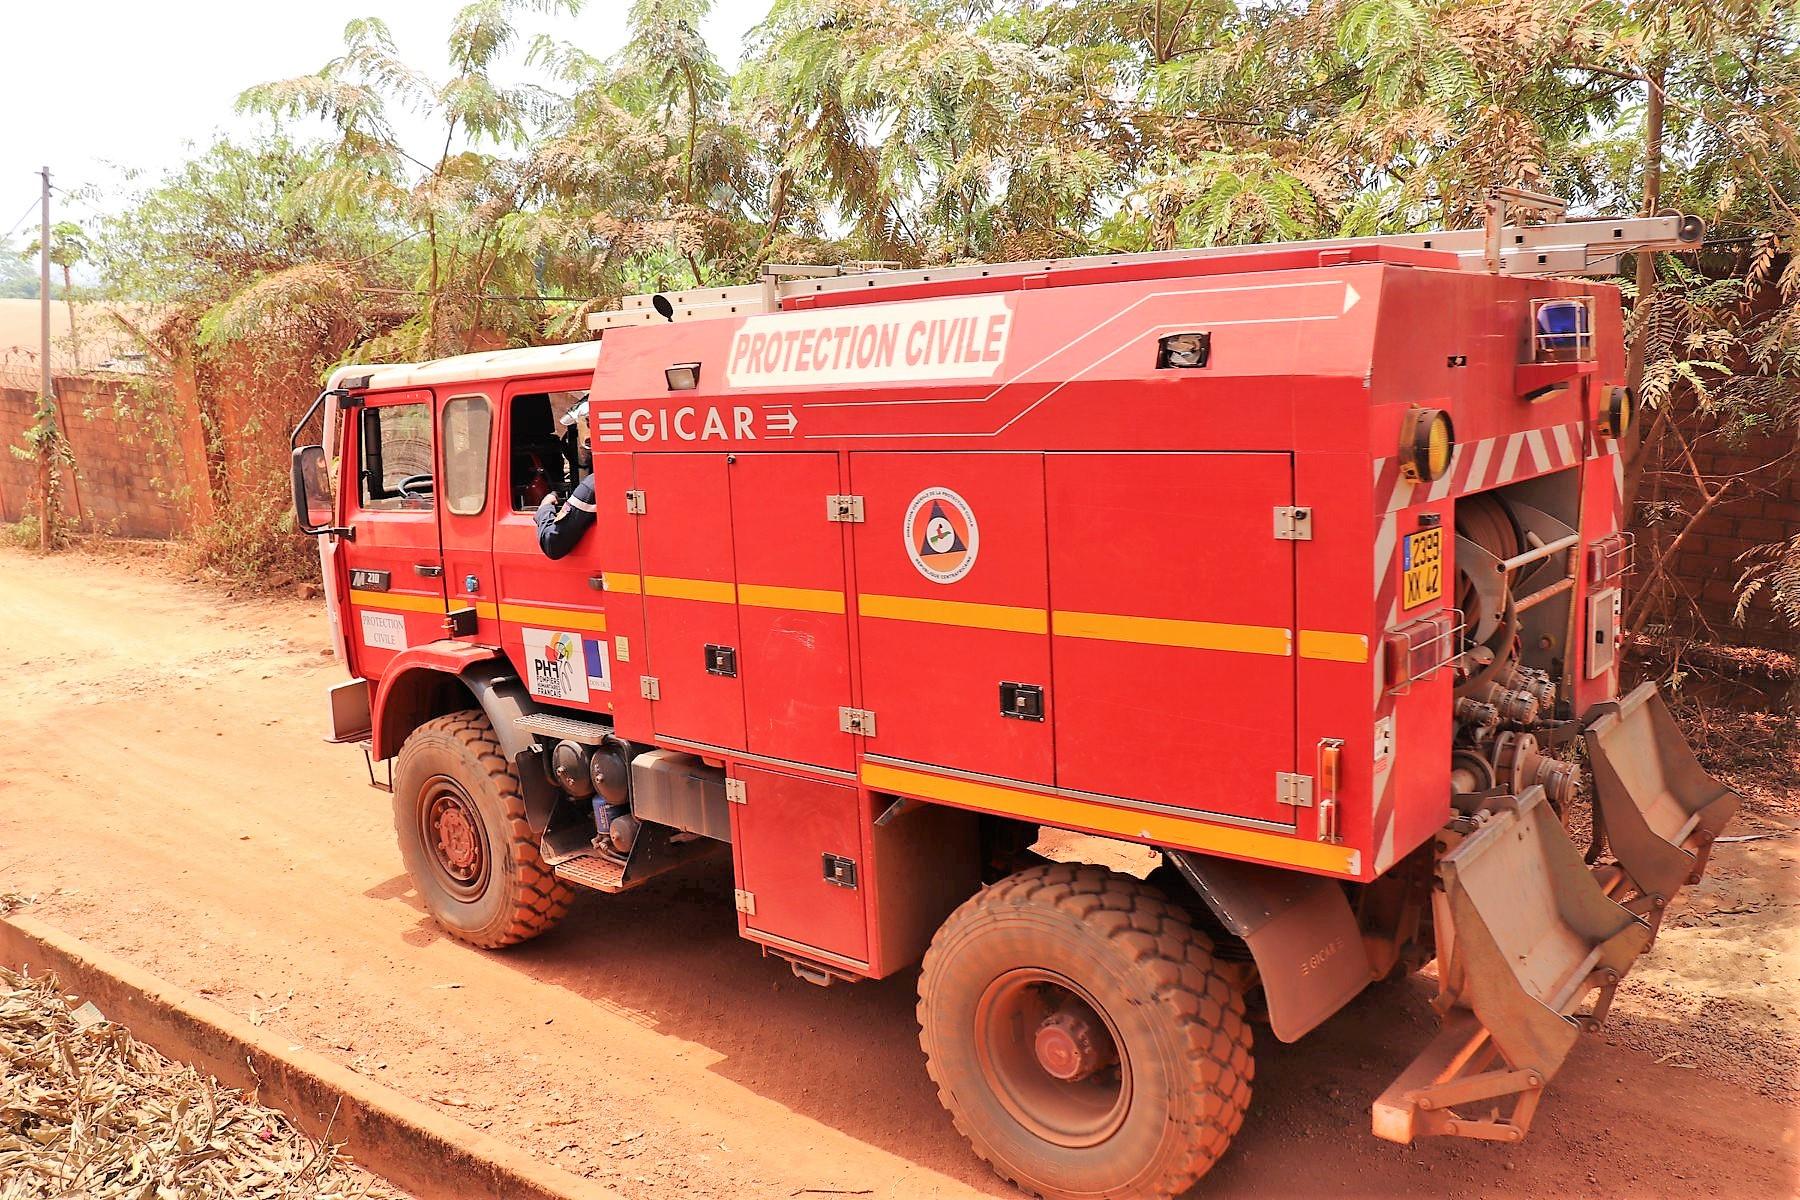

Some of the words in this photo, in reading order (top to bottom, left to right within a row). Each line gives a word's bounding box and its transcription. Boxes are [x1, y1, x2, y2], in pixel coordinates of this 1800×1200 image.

[731, 322, 900, 374] PROTECTION
[905, 314, 1006, 366] CIVILE
[1426, 564, 1439, 595] 42
[362, 615, 404, 630] PROTECTION
[373, 632, 396, 645] CIVILE
